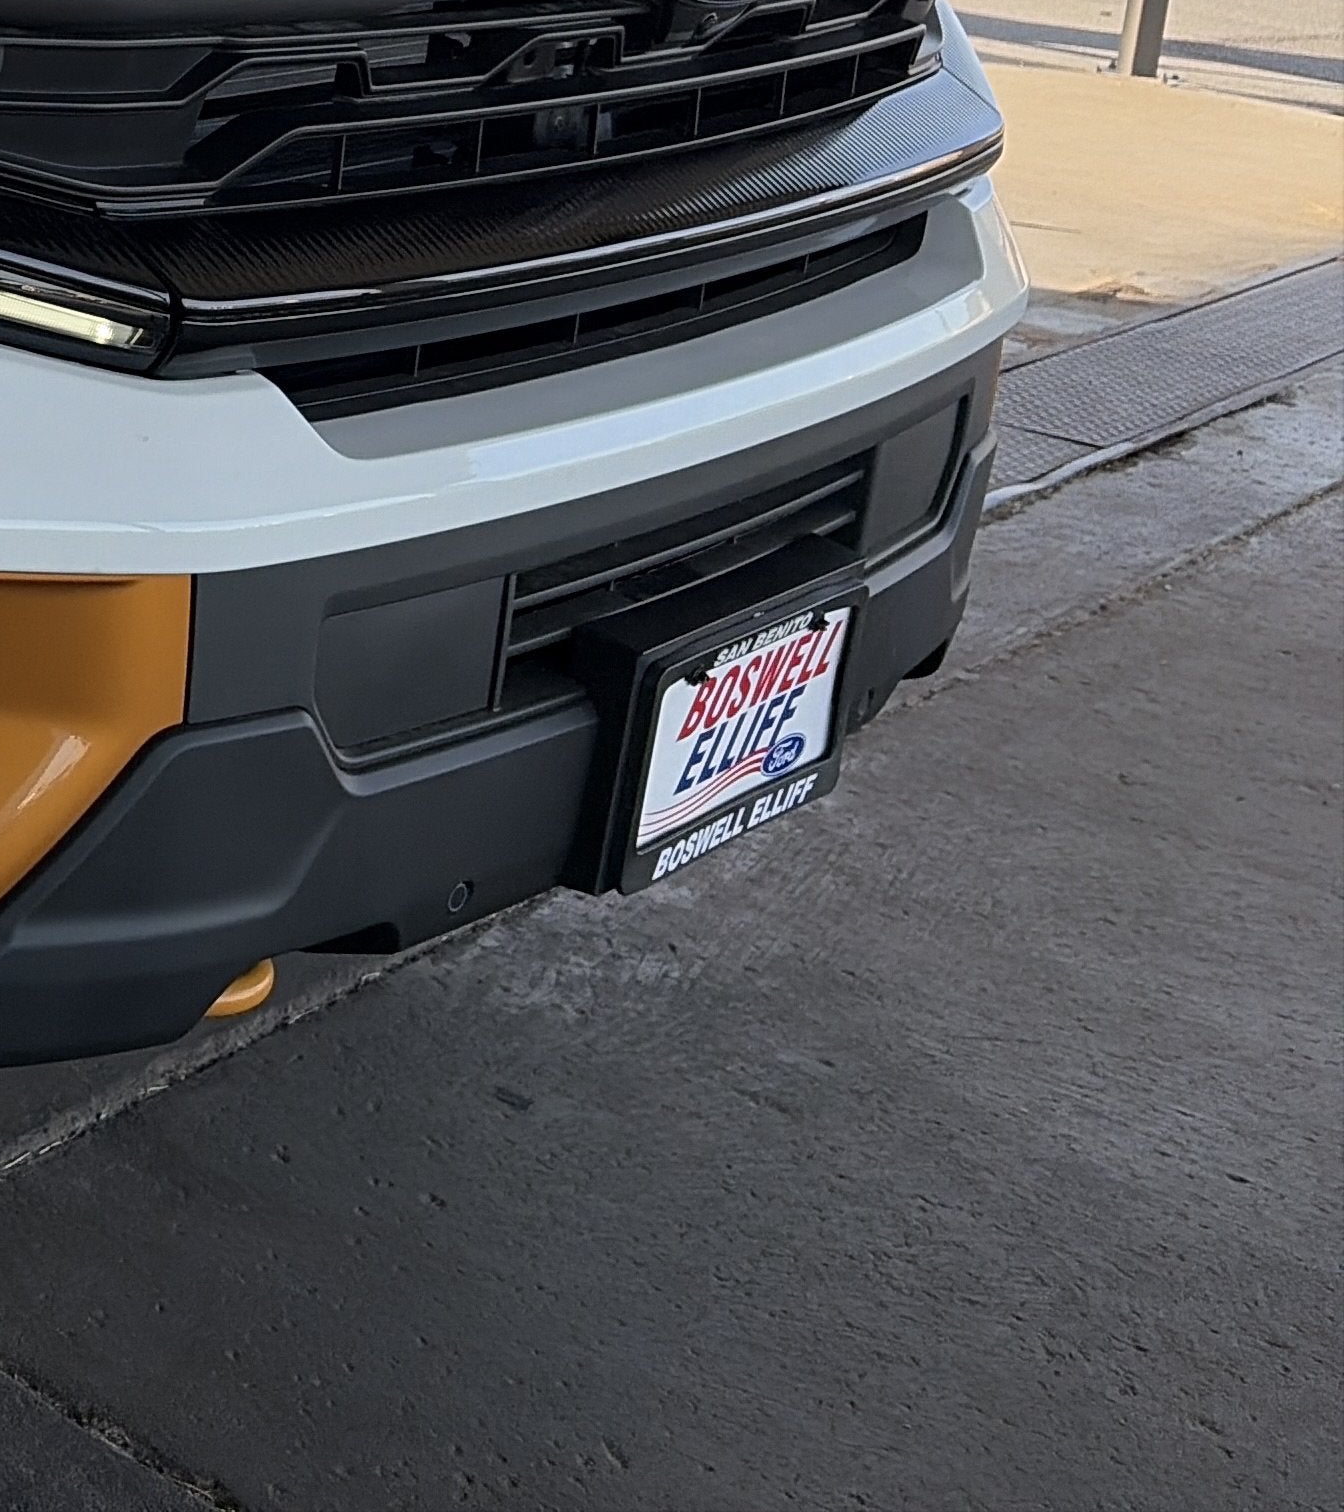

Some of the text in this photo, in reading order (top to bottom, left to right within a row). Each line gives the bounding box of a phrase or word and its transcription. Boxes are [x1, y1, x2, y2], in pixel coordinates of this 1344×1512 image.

[675, 619, 844, 743] BOSWELL
[713, 611, 814, 667] SAN BENITO
[673, 684, 808, 796] ELLIFF
[766, 738, 801, 772] Ford
[651, 773, 818, 881] BOSWELL ELLIFF
